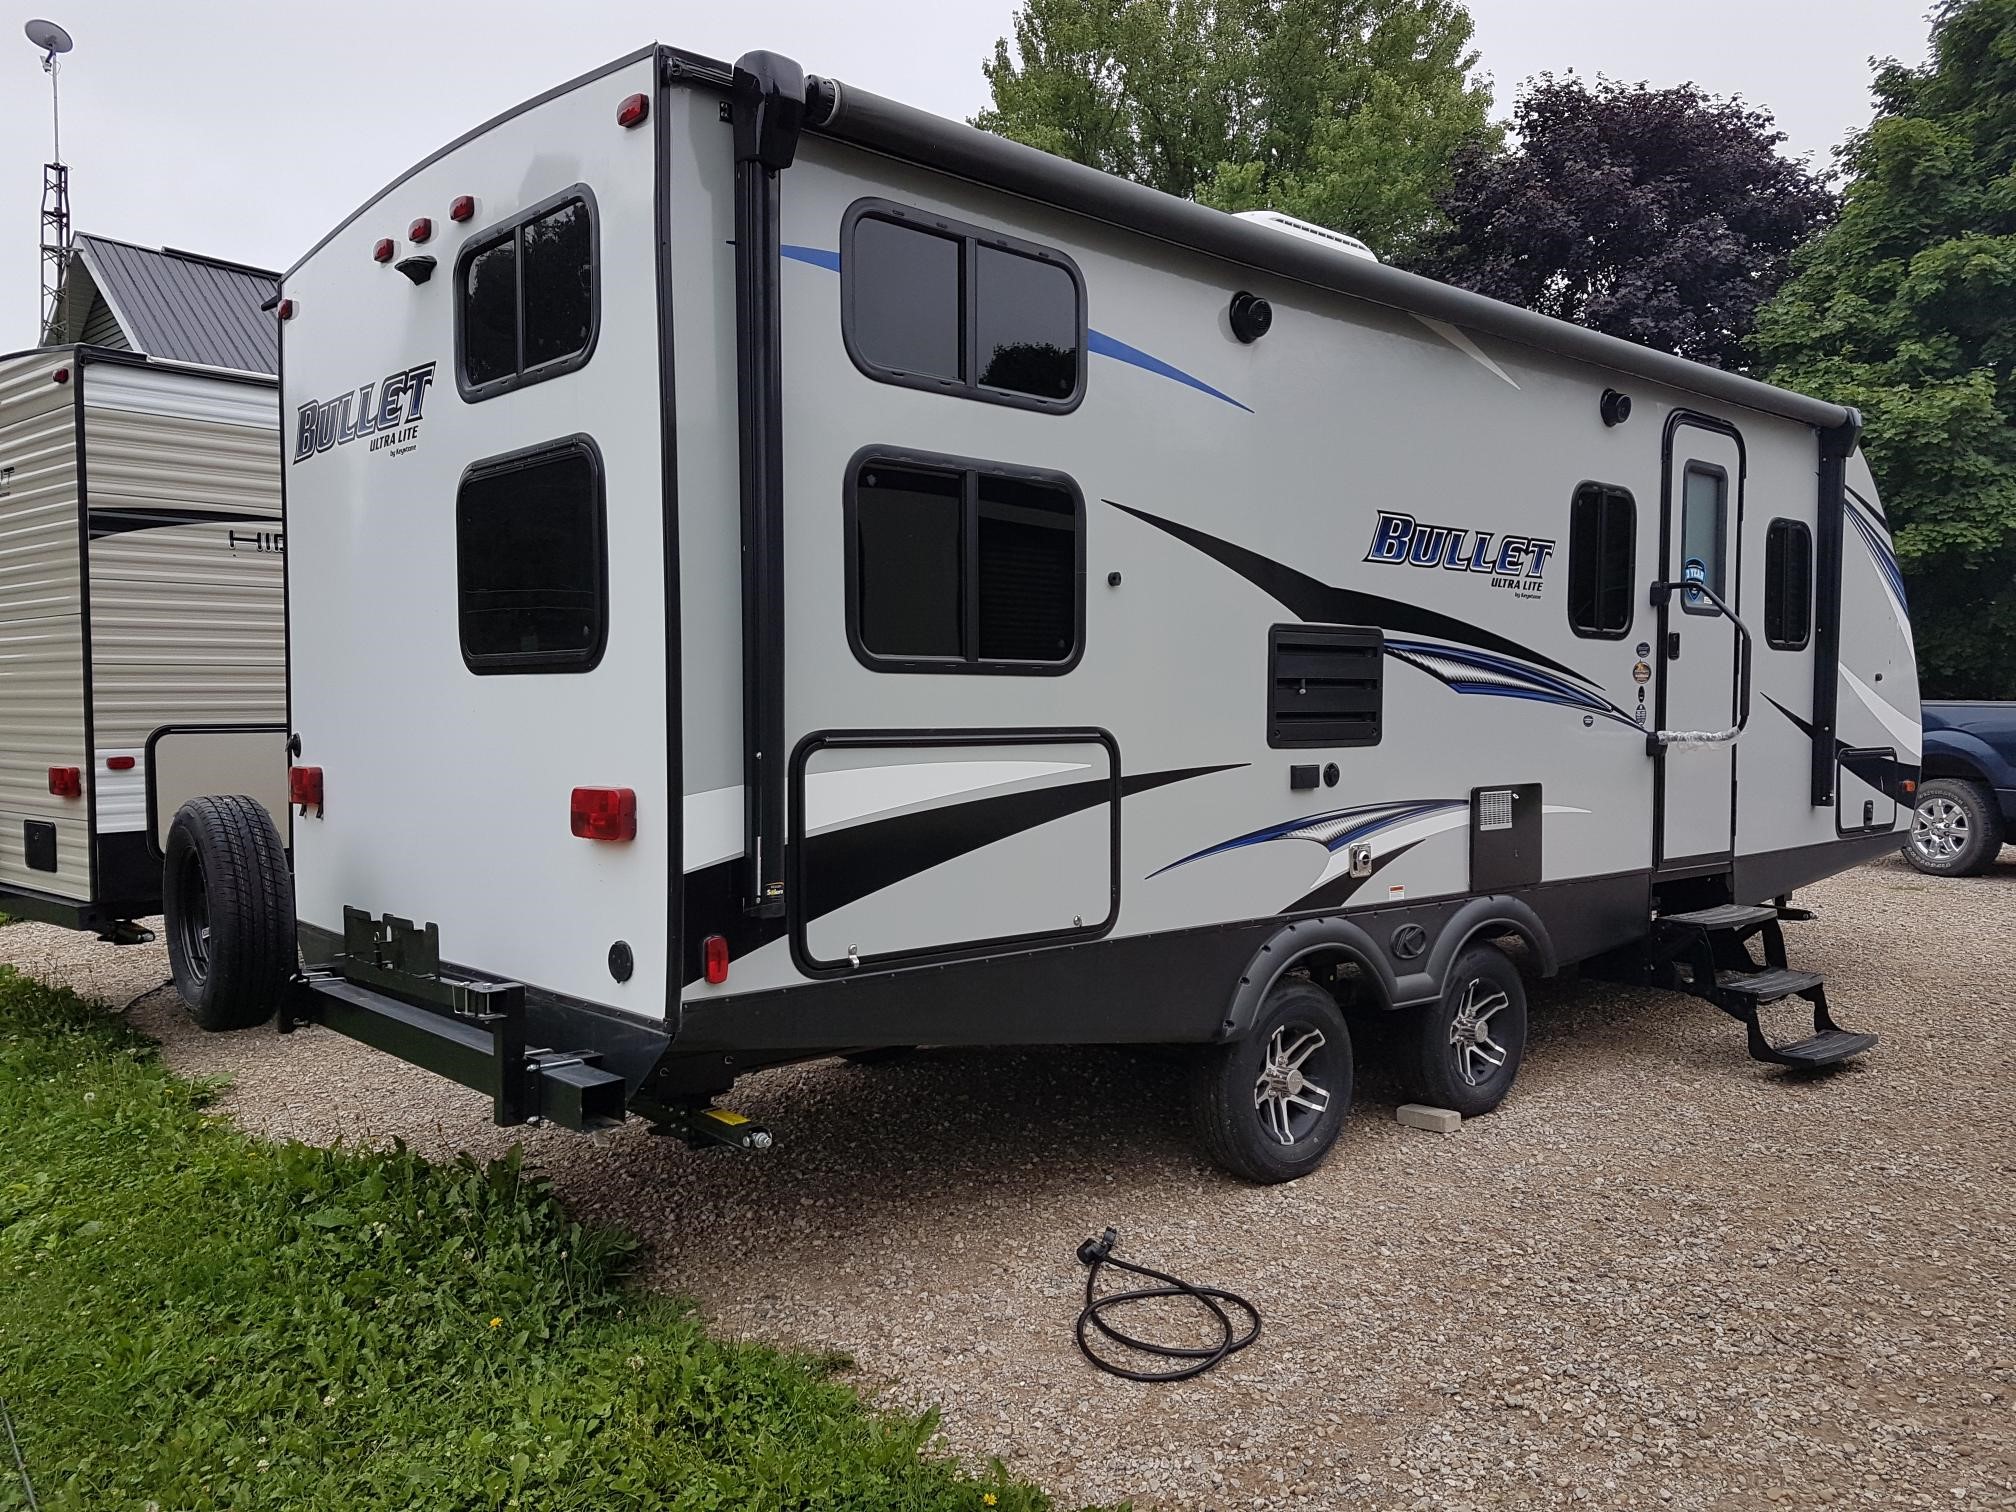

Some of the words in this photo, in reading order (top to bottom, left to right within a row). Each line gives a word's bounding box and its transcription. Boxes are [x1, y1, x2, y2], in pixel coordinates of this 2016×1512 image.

[293, 361, 437, 465] BULLET
[370, 432, 396, 452] ULTRA
[397, 425, 419, 443] LITE
[1361, 510, 1556, 579] BULLET
[1491, 577, 1521, 590] ULTRA
[1522, 580, 1544, 592] LITE
